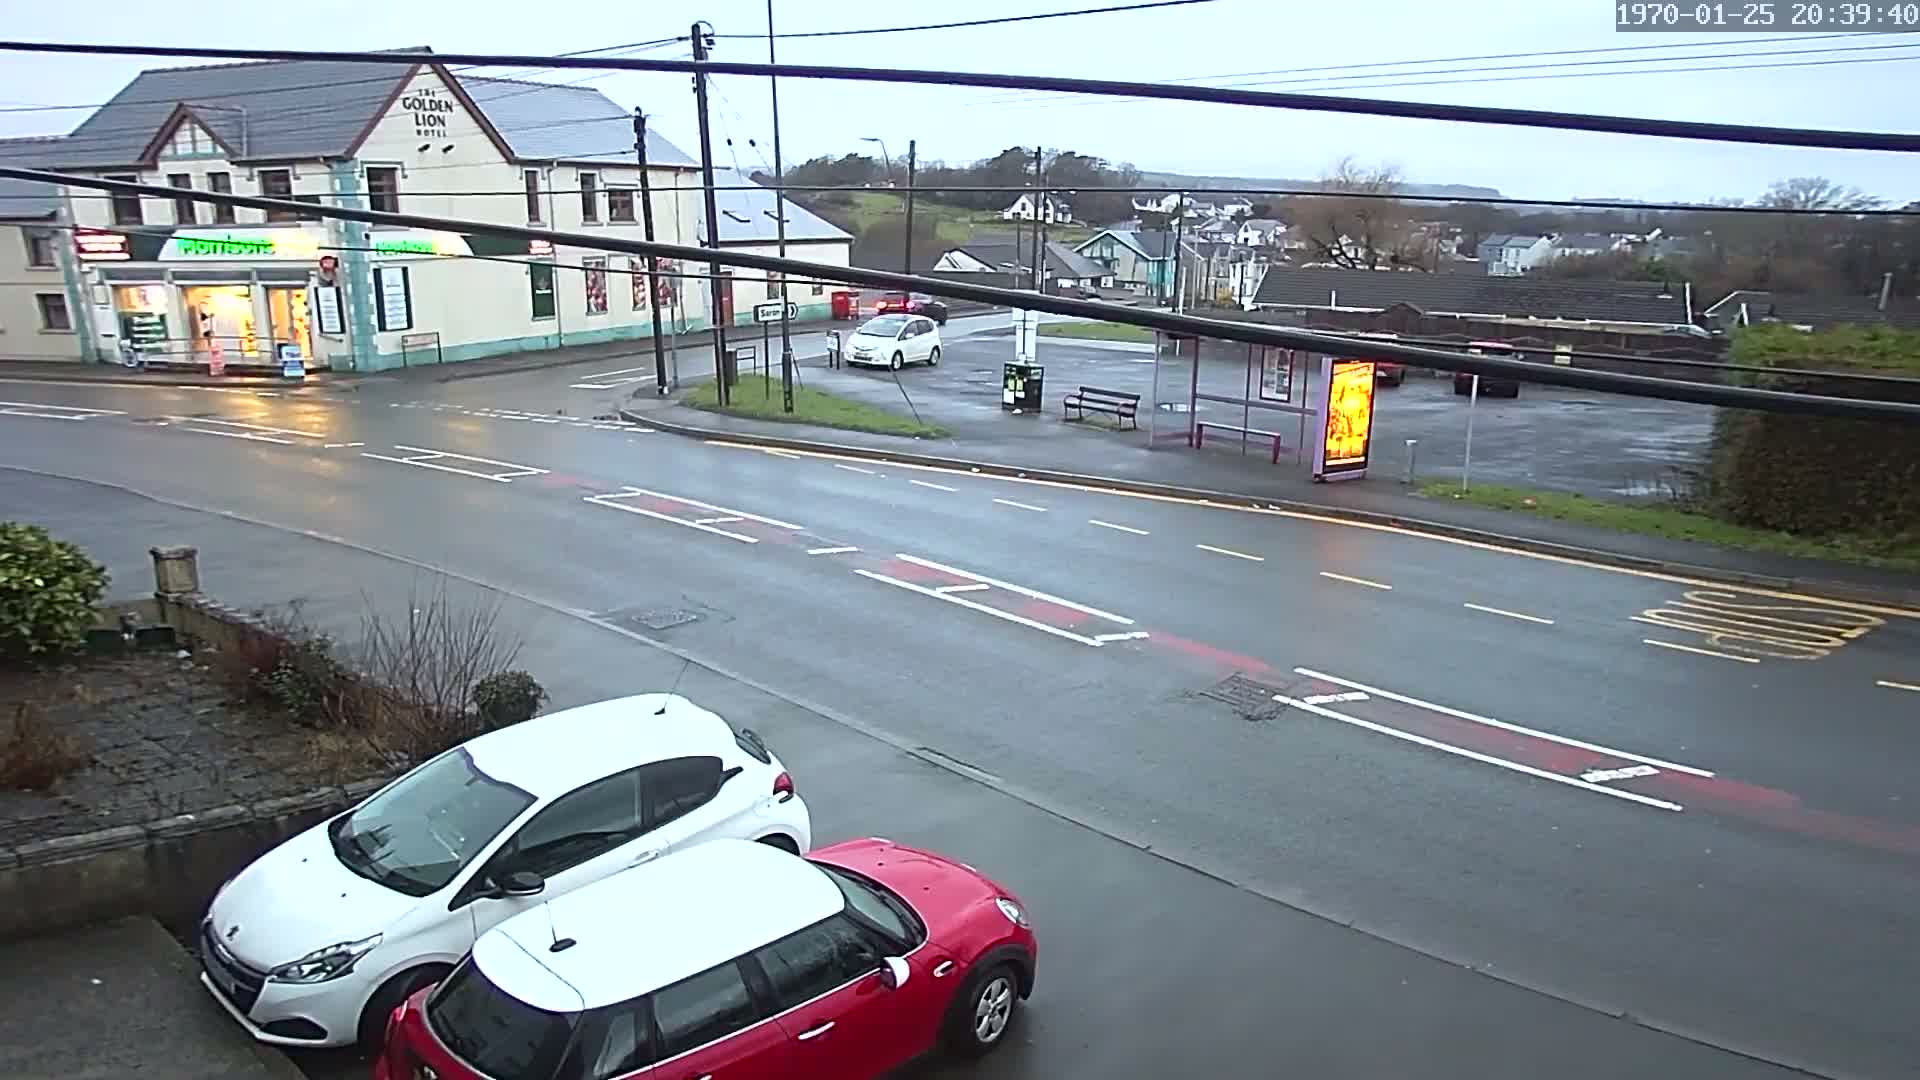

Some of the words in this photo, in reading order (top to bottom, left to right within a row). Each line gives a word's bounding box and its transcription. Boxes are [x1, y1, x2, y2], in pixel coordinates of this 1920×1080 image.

[418, 88, 435, 97] THE
[402, 97, 453, 112] GOLDEN
[415, 112, 446, 127] LION
[416, 129, 446, 138] HOTEL
